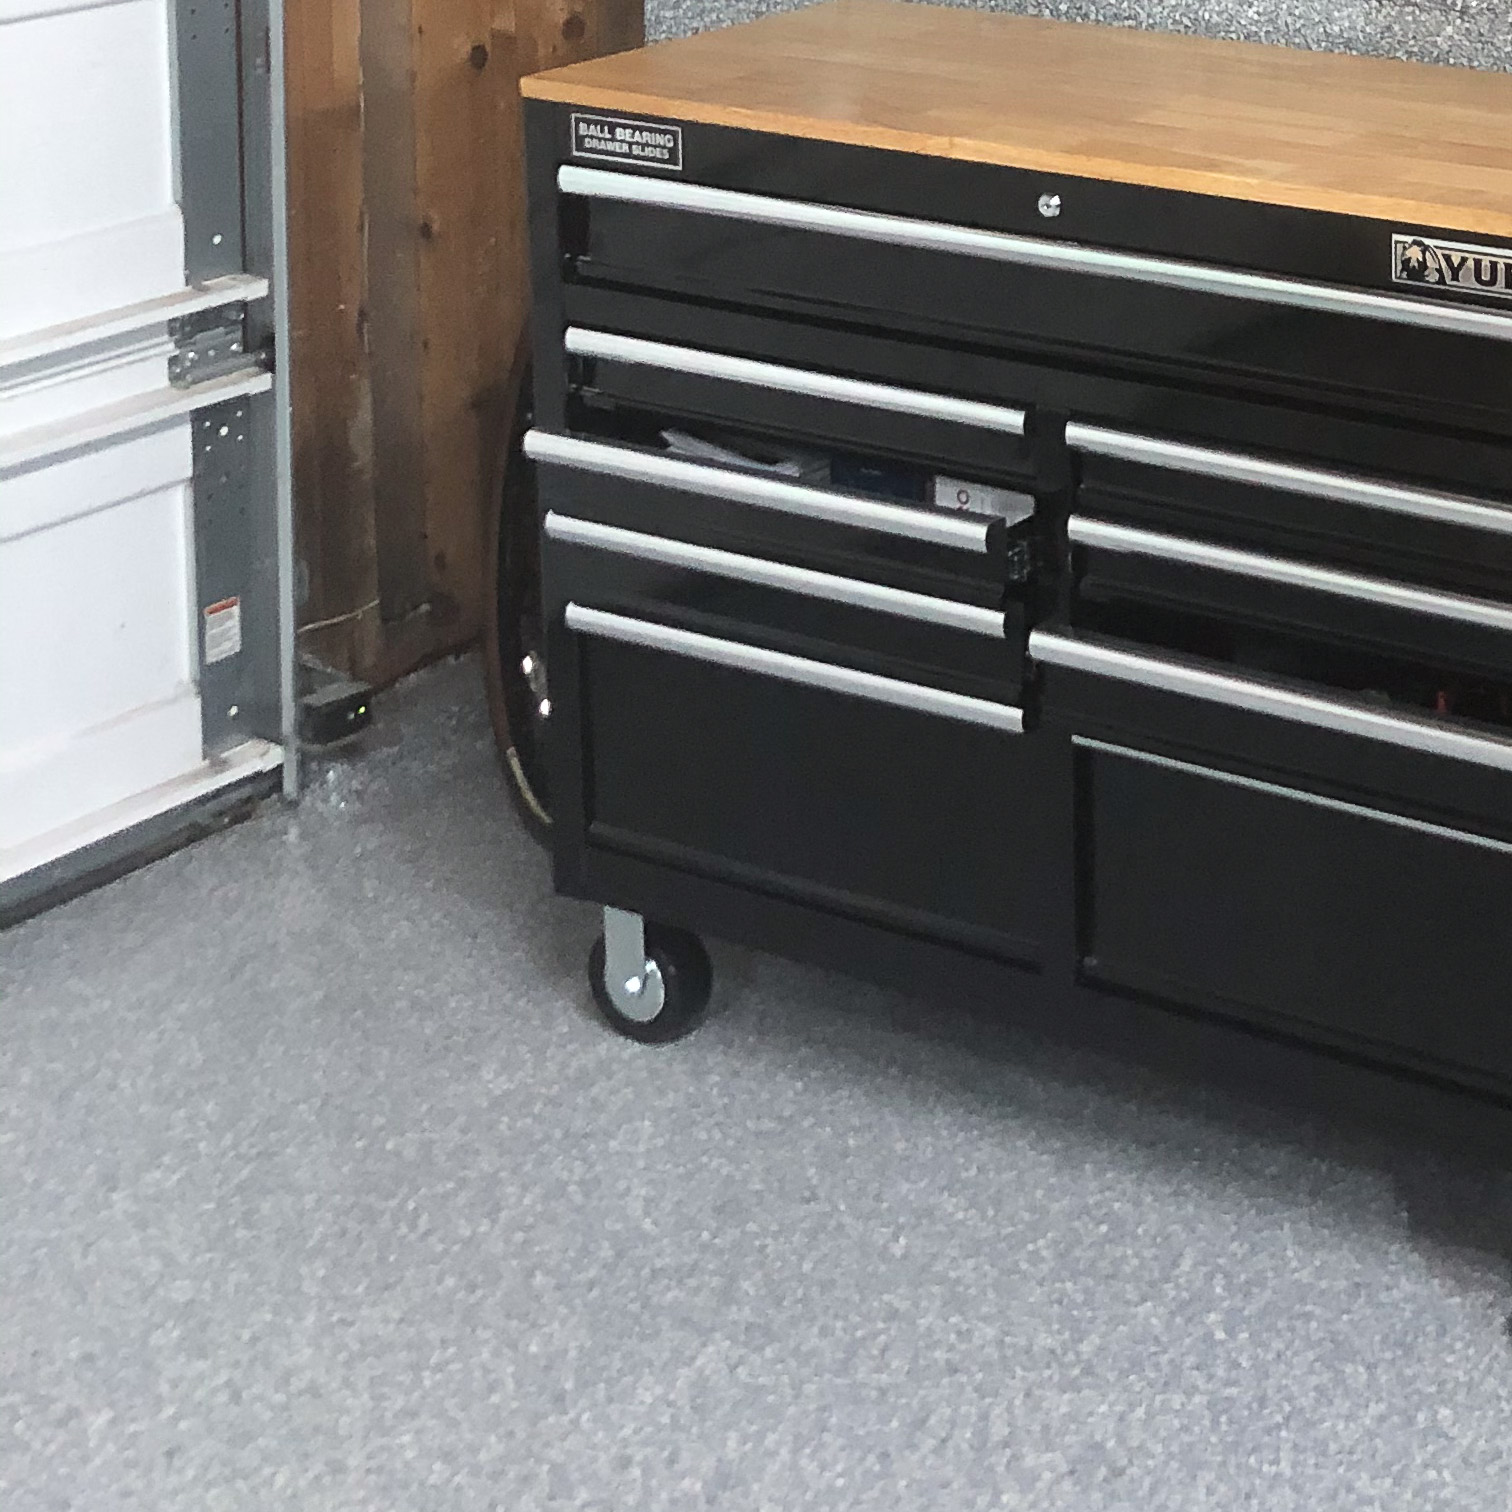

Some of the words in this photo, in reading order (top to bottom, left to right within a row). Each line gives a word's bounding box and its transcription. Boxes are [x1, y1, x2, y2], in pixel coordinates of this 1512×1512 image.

[578, 121, 612, 139] BALL
[615, 127, 675, 148] BEARING
[584, 137, 630, 154] DRAWER
[632, 144, 670, 160] SLIDES
